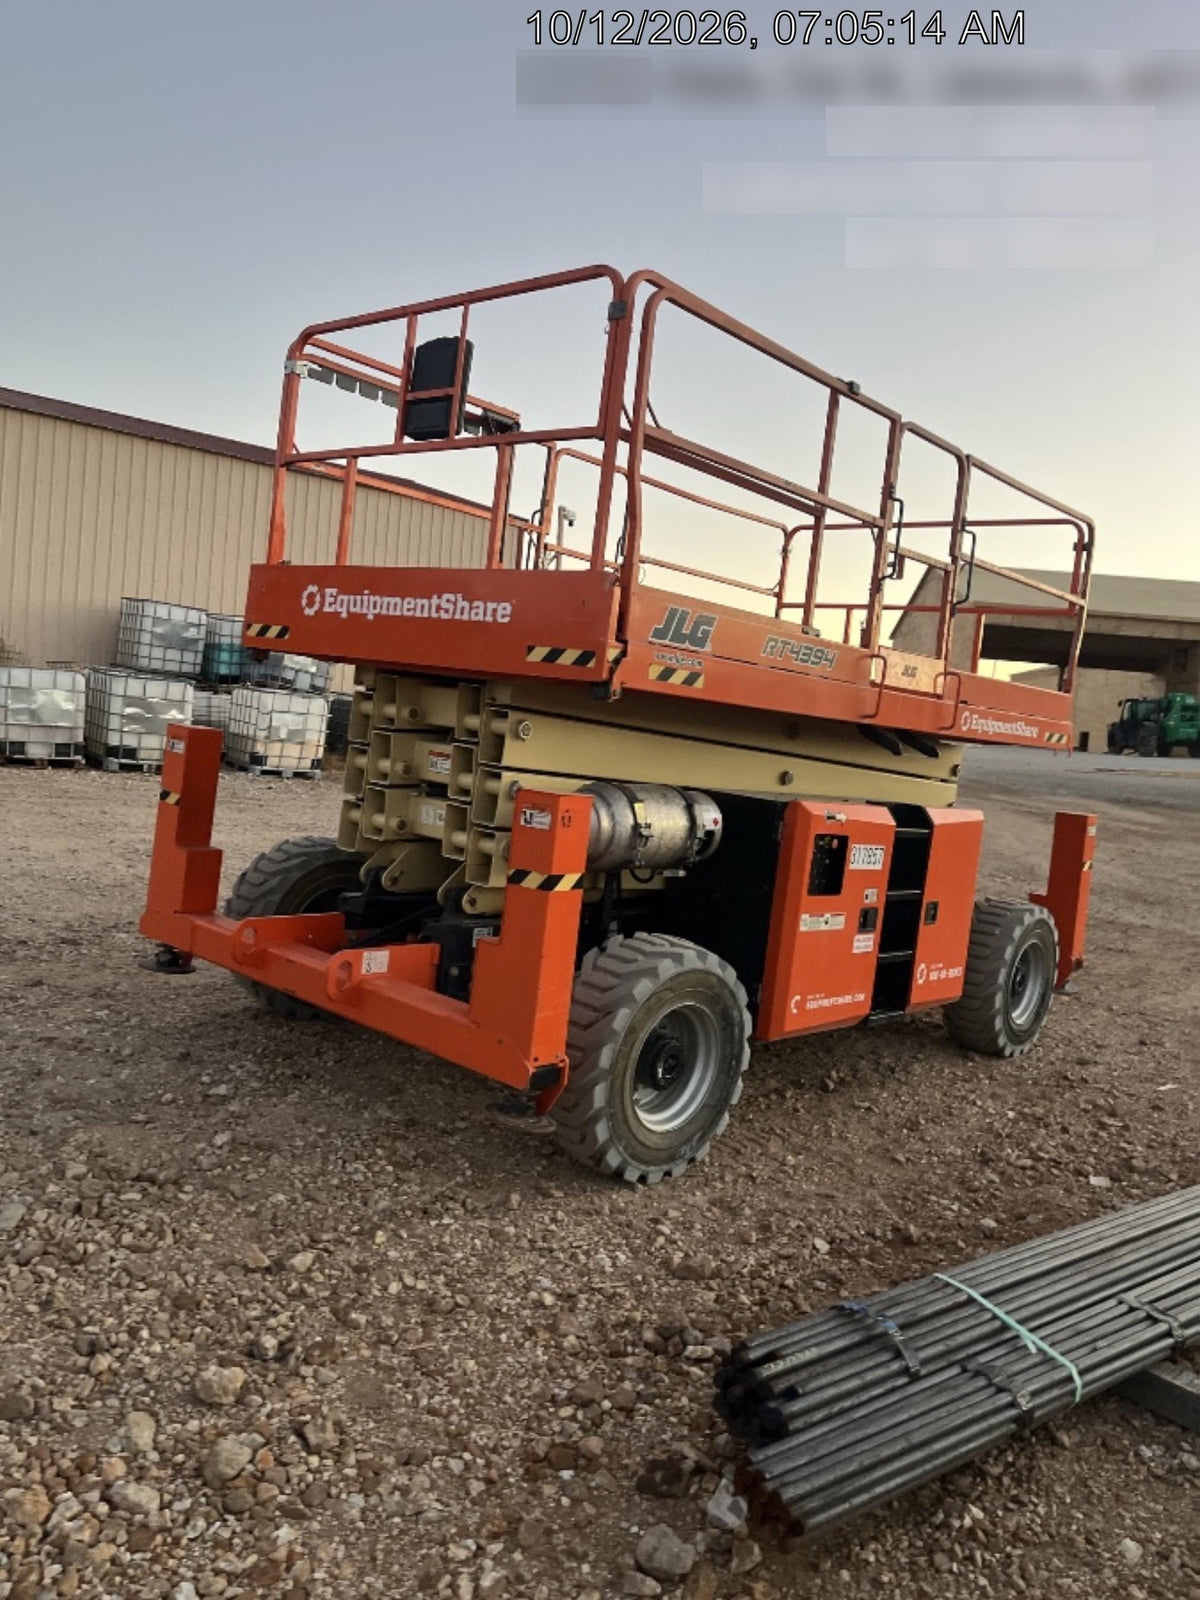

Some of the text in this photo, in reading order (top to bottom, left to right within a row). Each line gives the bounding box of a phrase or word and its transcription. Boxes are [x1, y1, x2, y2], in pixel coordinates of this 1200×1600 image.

[323, 588, 513, 624] EquipmentShare
[648, 604, 718, 652] JLG
[761, 634, 838, 671] RT4394
[971, 714, 1039, 738] EquipmentShare
